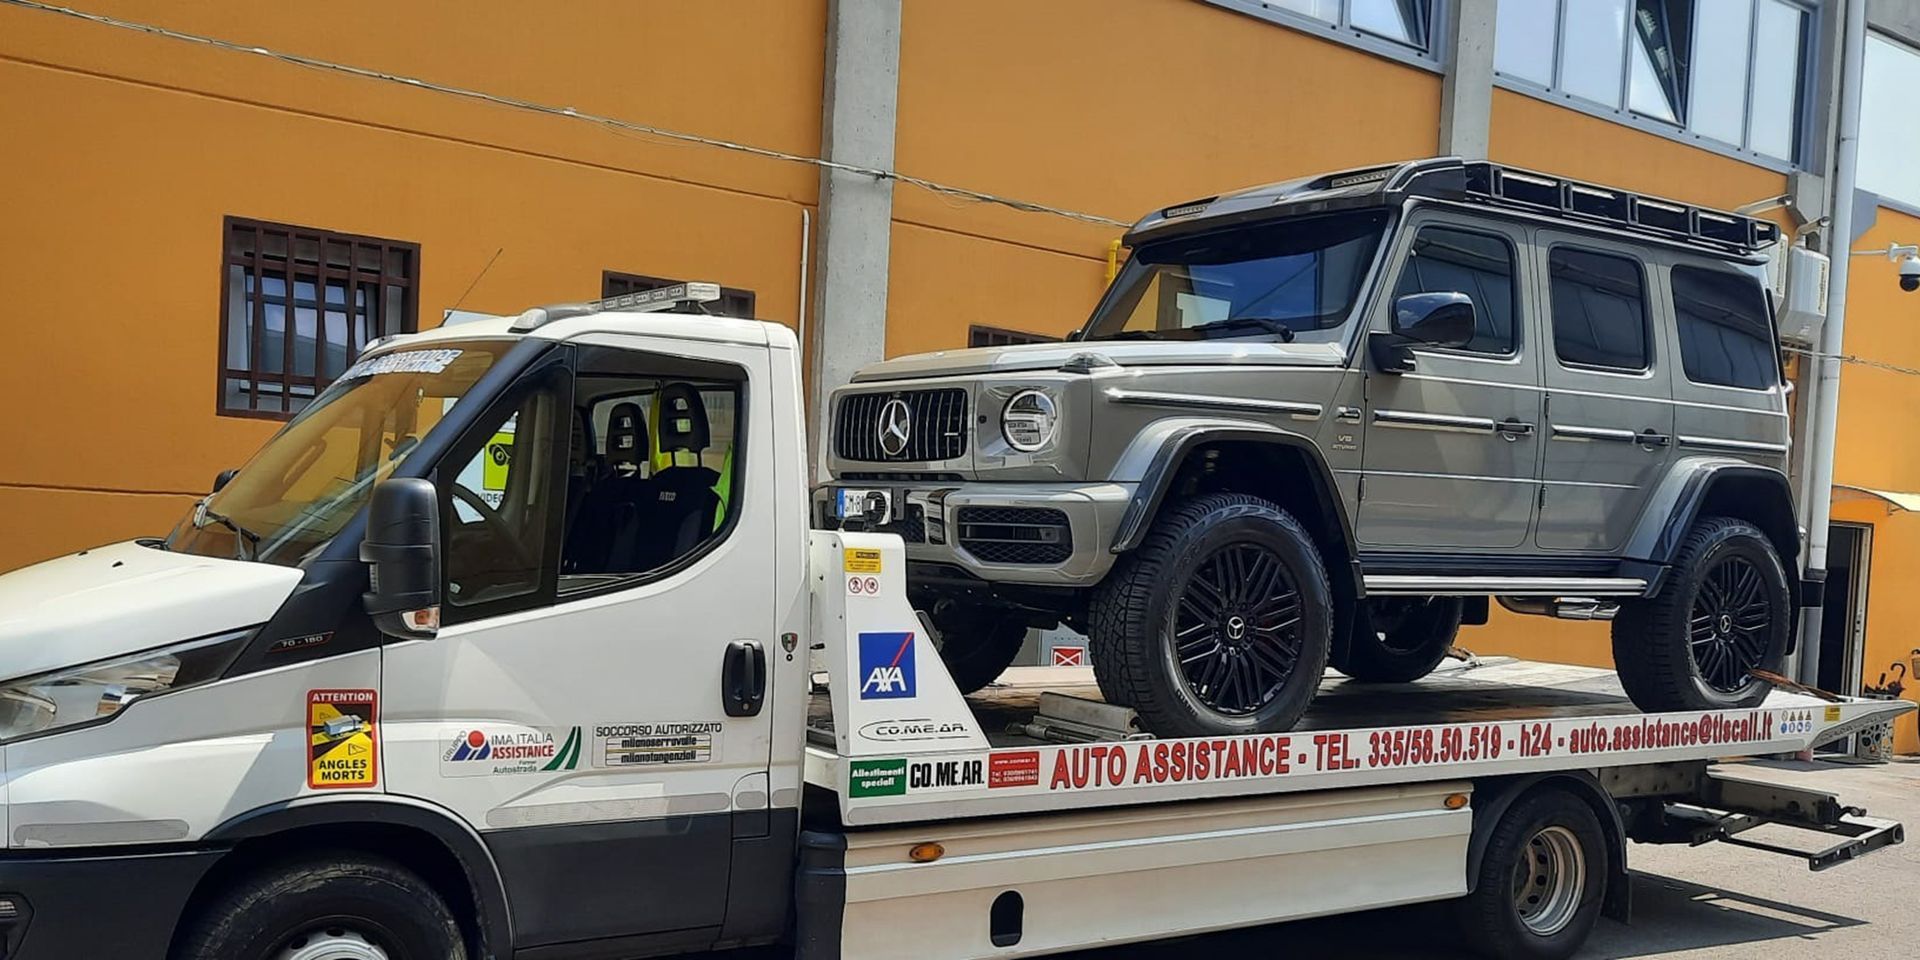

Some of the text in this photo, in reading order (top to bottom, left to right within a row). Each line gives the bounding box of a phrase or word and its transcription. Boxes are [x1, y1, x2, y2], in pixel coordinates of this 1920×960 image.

[861, 666, 907, 693] AXA
[312, 692, 373, 702] ATTENTION
[596, 723, 722, 737] SOCCORSO AUTORIZZATO
[491, 733, 554, 745] IMA ITALIA
[442, 730, 467, 762] GRUPPO
[492, 745, 554, 760] ASSISTANCE
[1050, 746, 1127, 790] AUTO
[1133, 737, 1292, 784] ASSISTANCE
[1313, 734, 1360, 771] TEL.
[1368, 725, 1501, 768] 335/58.50.519
[1520, 723, 1552, 757] h24
[319, 759, 367, 770] ANGLES
[493, 764, 537, 774] Autostrada
[321, 770, 365, 781] MORTS
[852, 767, 905, 778] Allestimenti
[909, 760, 985, 788] CO.ME.AR.
[861, 777, 895, 789] speciali
